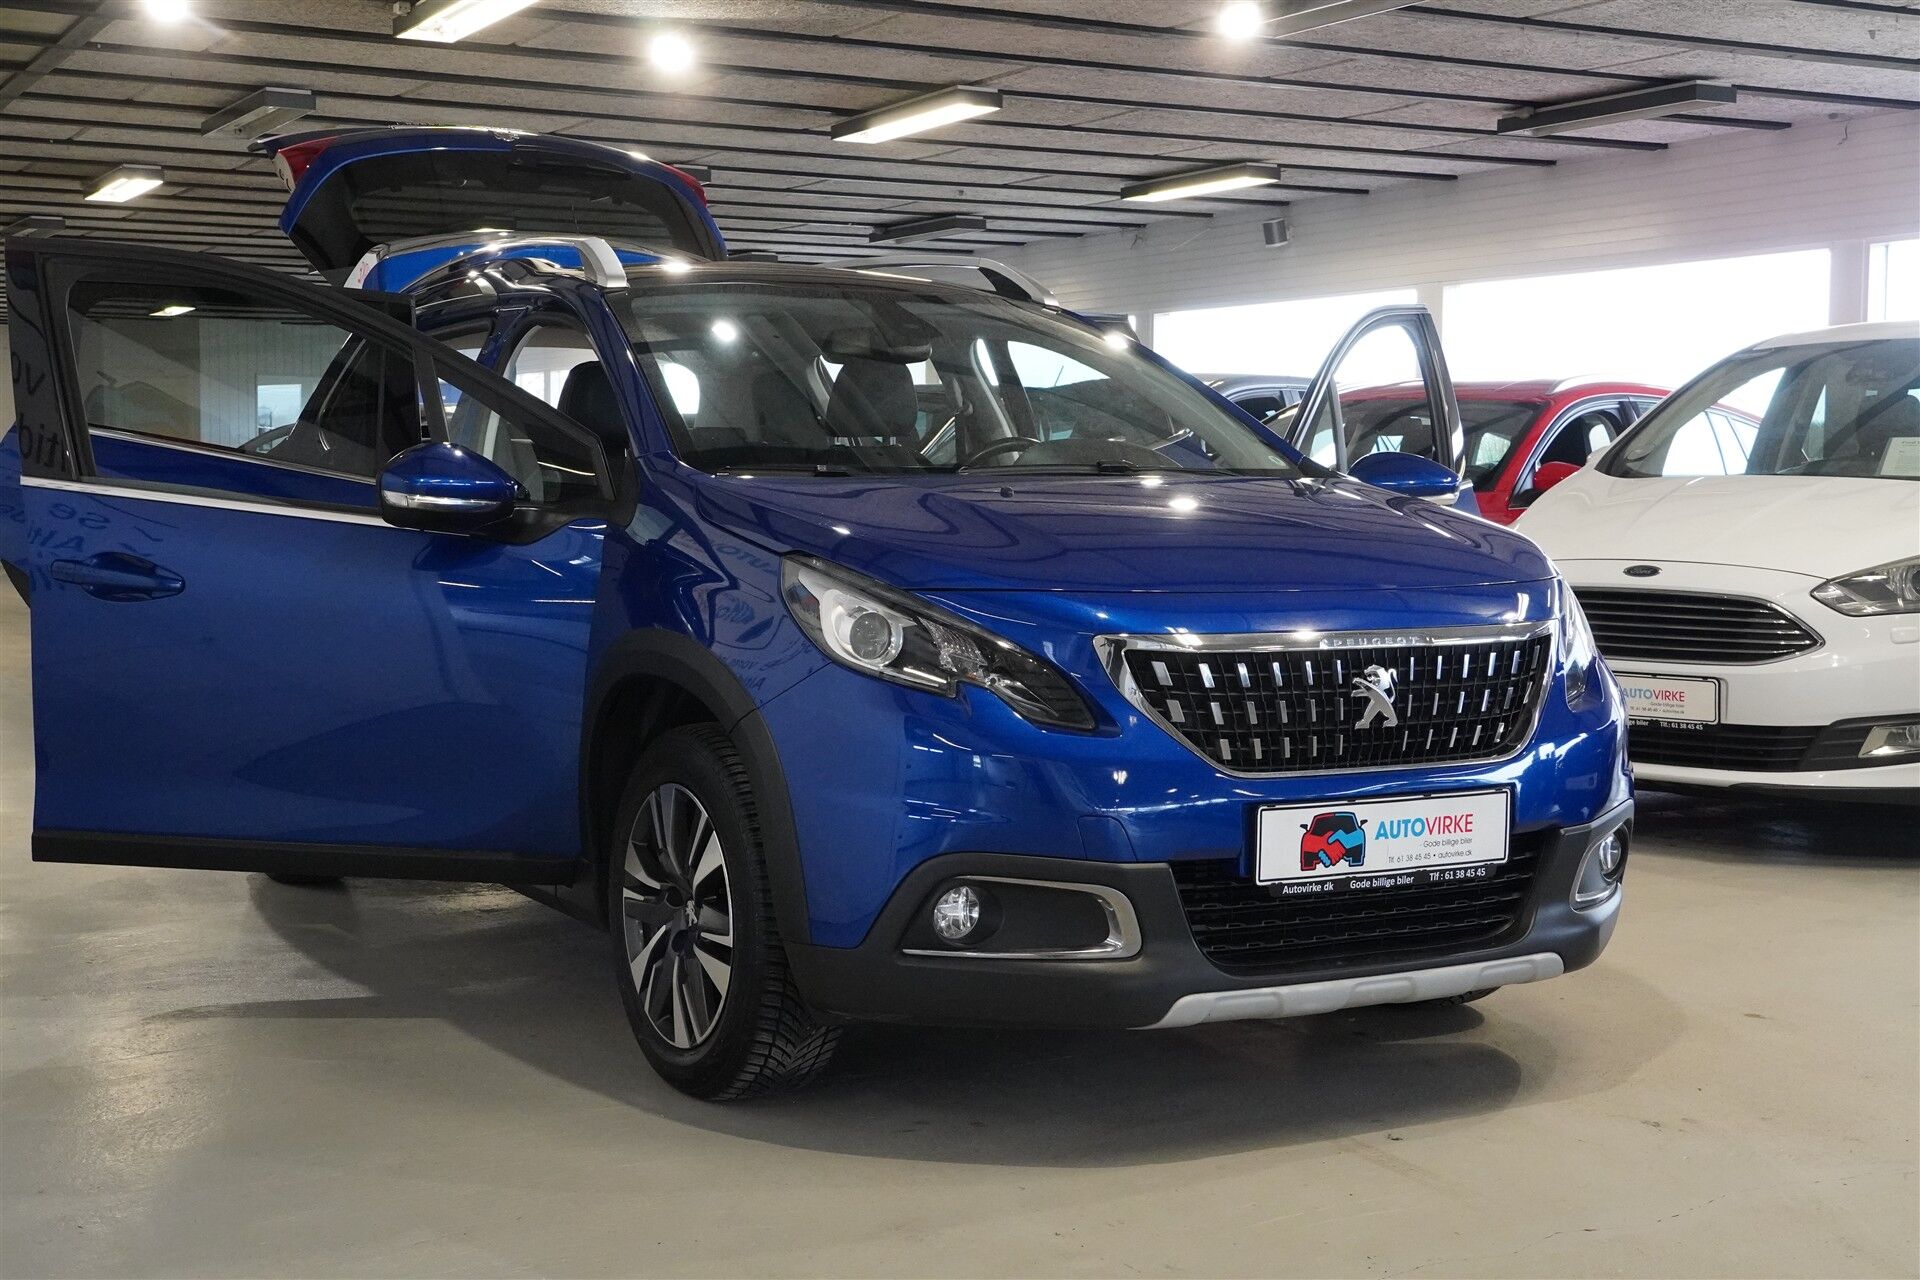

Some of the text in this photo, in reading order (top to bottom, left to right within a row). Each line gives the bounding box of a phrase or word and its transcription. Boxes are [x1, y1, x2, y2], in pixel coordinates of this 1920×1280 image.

[1333, 635, 1420, 647] PEUGEOT
[1623, 687, 1685, 702] AUTOVIRKE
[1374, 813, 1474, 840] AUTOVIRKE
[1423, 837, 1473, 848] Gode billige biler
[1396, 855, 1404, 863] 61
[1406, 854, 1413, 862] 38
[1415, 853, 1422, 861] 45
[1423, 852, 1431, 860] 45
[1282, 883, 1322, 895] Autovirke
[1350, 879, 1371, 889] Gode
[1372, 877, 1395, 889] billige
[1396, 876, 1415, 886] biler
[1444, 870, 1454, 880] 61
[1455, 869, 1465, 878] 38
[1466, 868, 1475, 878] 45
[1476, 867, 1486, 876] 45
